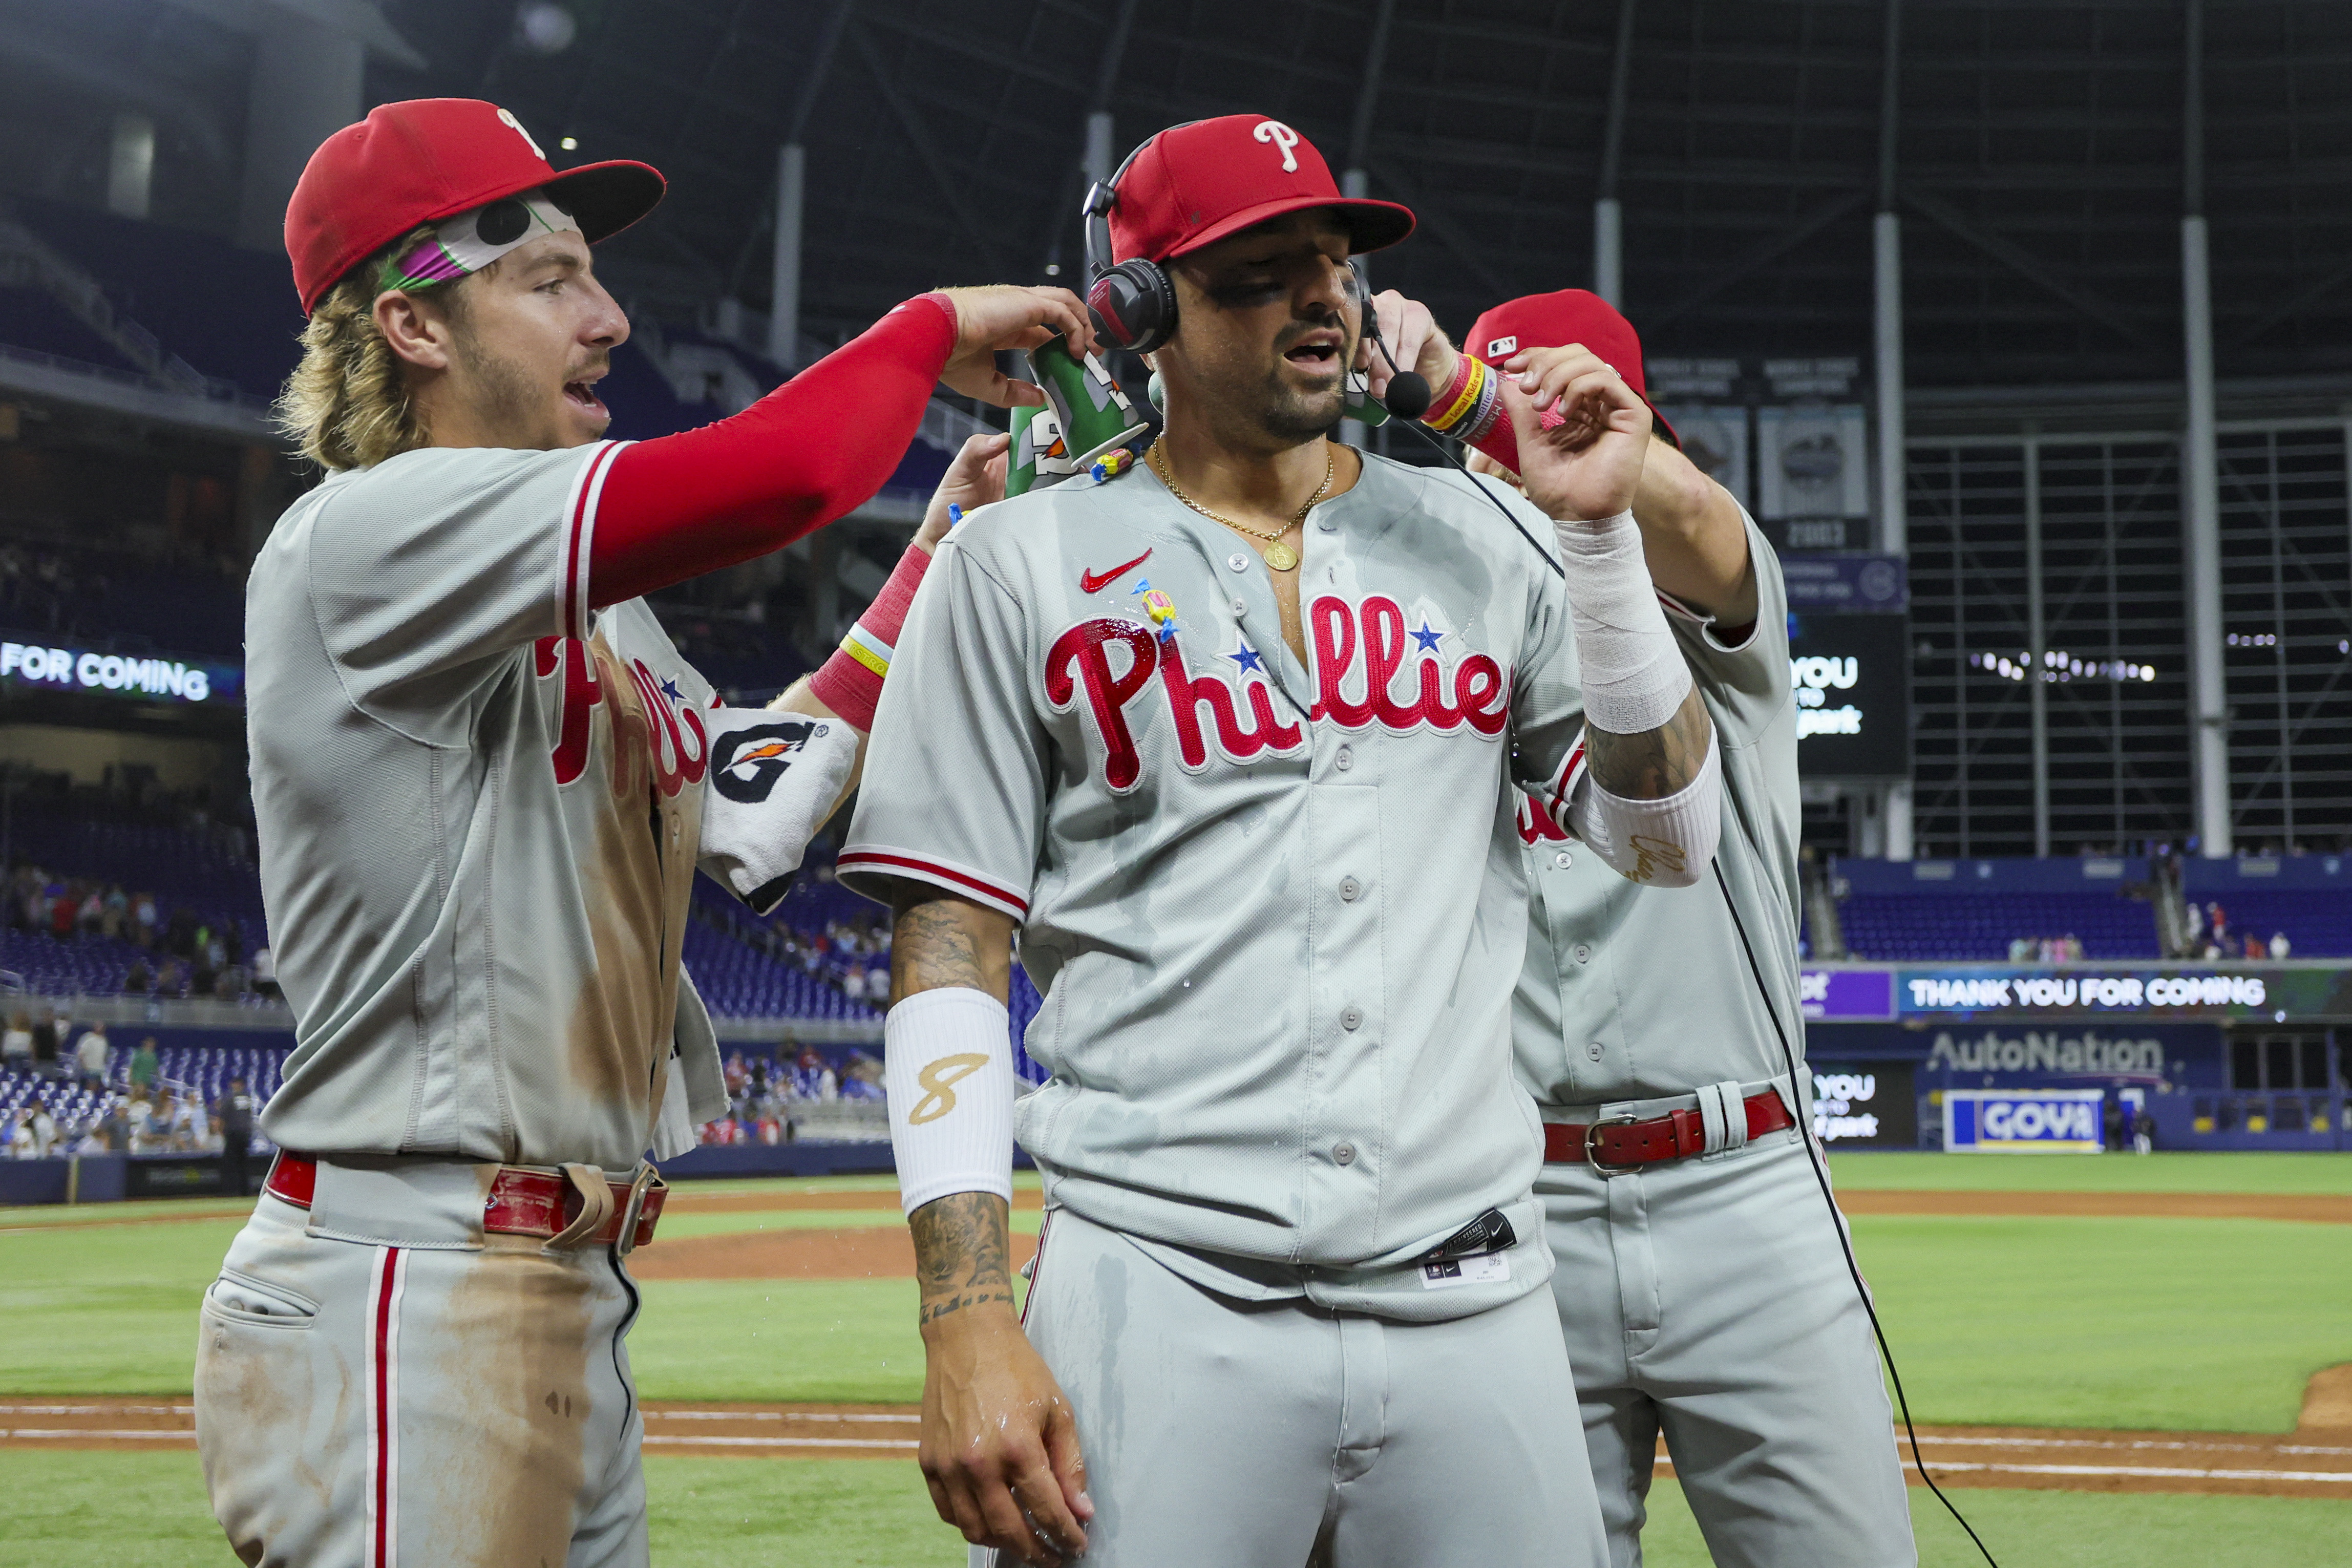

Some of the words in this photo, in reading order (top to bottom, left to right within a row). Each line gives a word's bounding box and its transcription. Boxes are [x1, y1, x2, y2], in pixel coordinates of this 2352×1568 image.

[1253, 120, 1299, 173] P
[1450, 398, 1469, 418] Local
[1465, 379, 1480, 398] Kids
[1, 642, 72, 684] FOR
[77, 653, 209, 701] COMING
[1789, 656, 1858, 689] YOU
[1045, 594, 1513, 795] Phillie
[1908, 979, 2011, 1007] THANK
[2012, 978, 2077, 1007] YOU
[2080, 978, 2144, 1007] FOR
[2146, 976, 2266, 1007] COMING
[1926, 1031, 2164, 1071] AutoNation
[908, 1052, 990, 1126] 8
[1813, 1074, 1876, 1101] YOU
